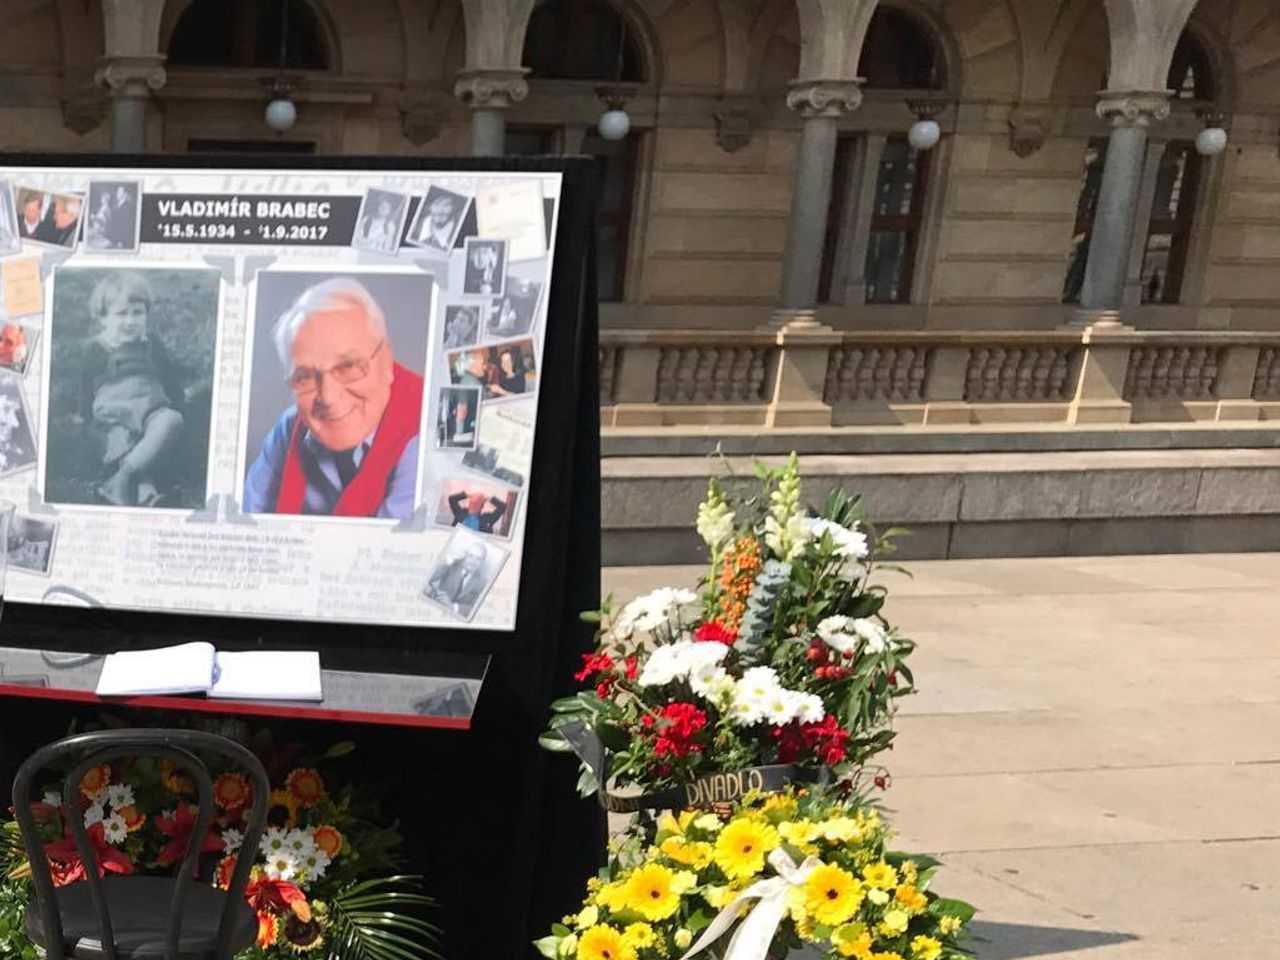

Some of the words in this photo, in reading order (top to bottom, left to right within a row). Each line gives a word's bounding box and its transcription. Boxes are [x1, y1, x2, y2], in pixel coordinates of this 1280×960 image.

[158, 196, 251, 217] VLADIMÍR
[256, 201, 331, 218] BRABEC
[686, 769, 763, 806] DIVADLO
